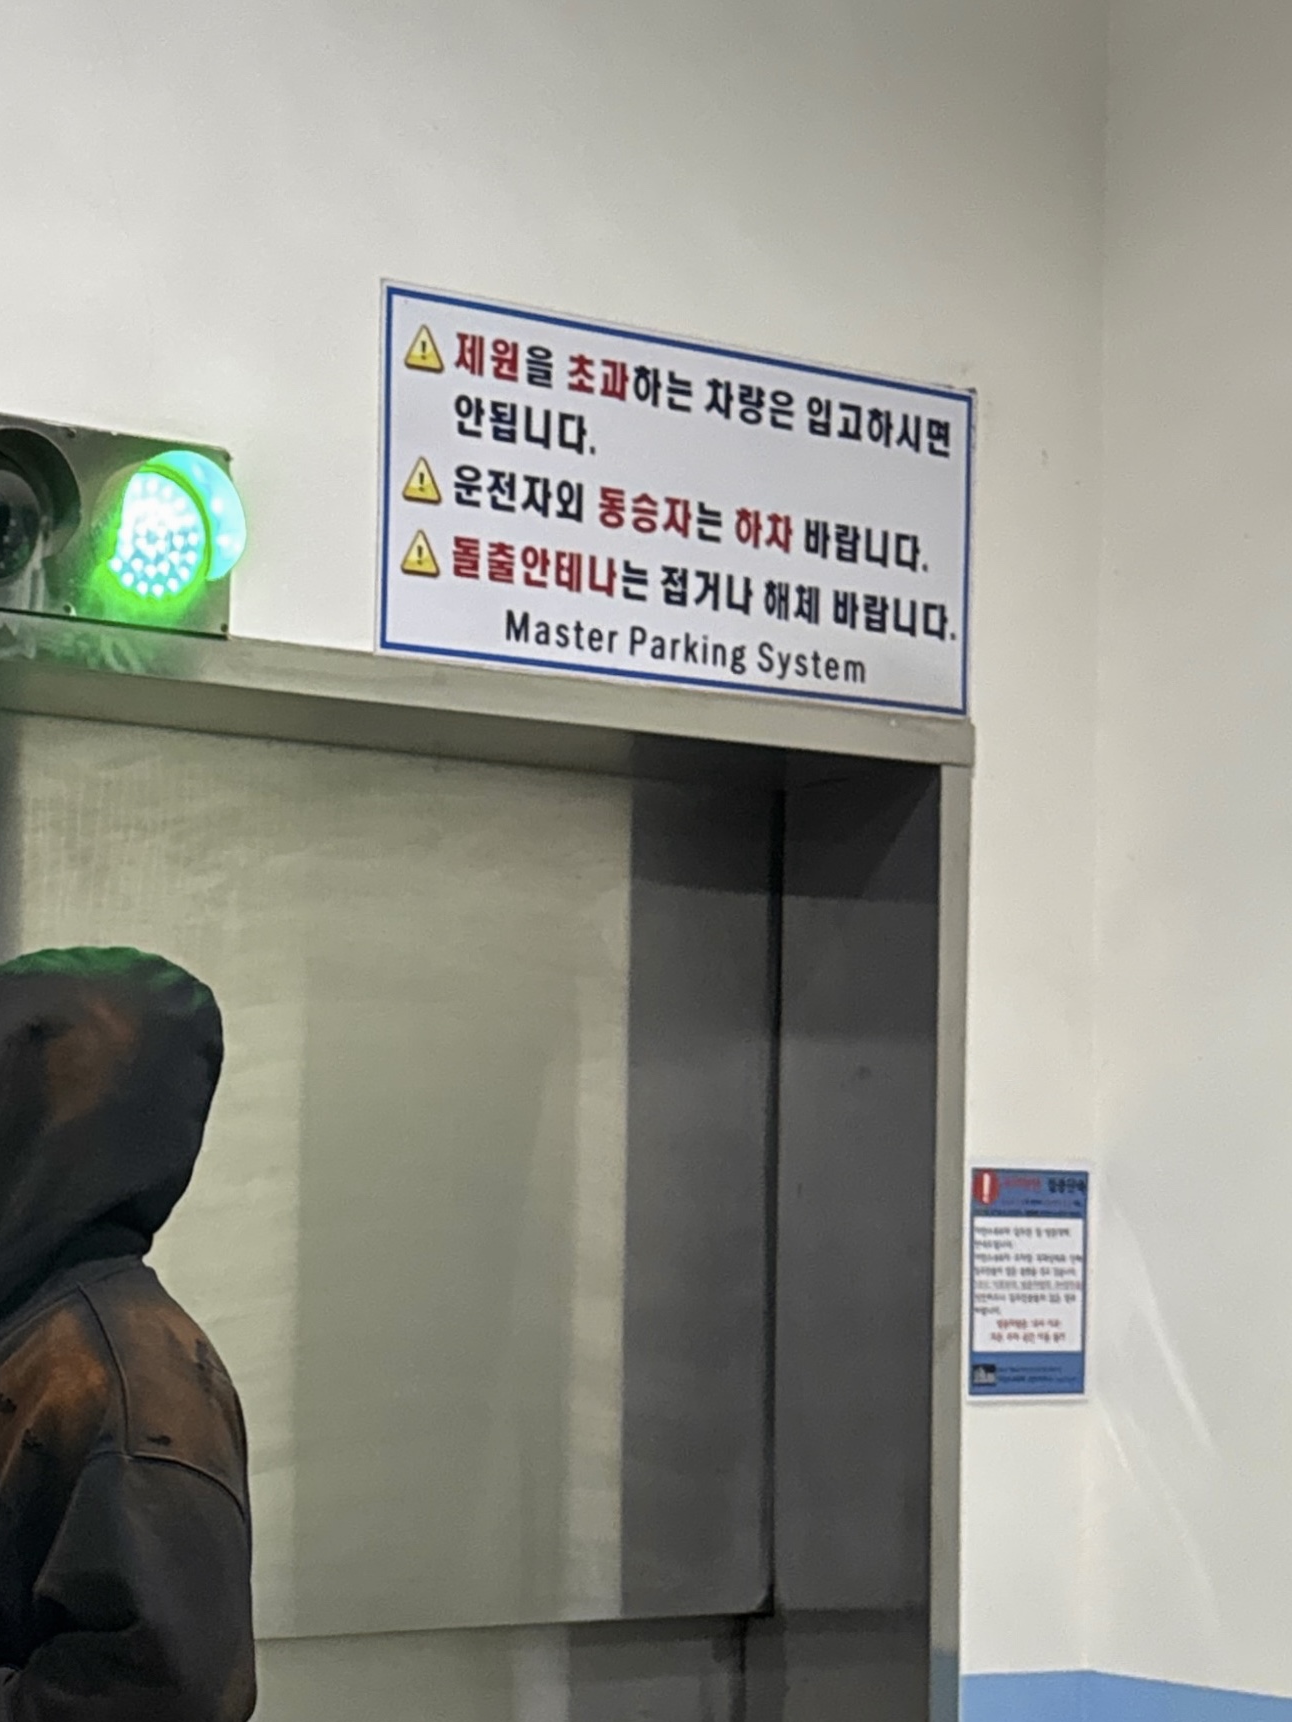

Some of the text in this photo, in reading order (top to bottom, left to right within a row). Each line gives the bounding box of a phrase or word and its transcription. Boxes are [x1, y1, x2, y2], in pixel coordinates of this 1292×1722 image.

[454, 394, 596, 455] 안됩니다.
[455, 331, 951, 459] 제원을 초과하는 차량은 입고하시면
[453, 464, 928, 573] 운전자외 동승자는 하차 바랍니다.
[453, 536, 957, 641] 돌출안테나는 접거나 해체 바랍니다.
[505, 608, 866, 684] Master Parking System
